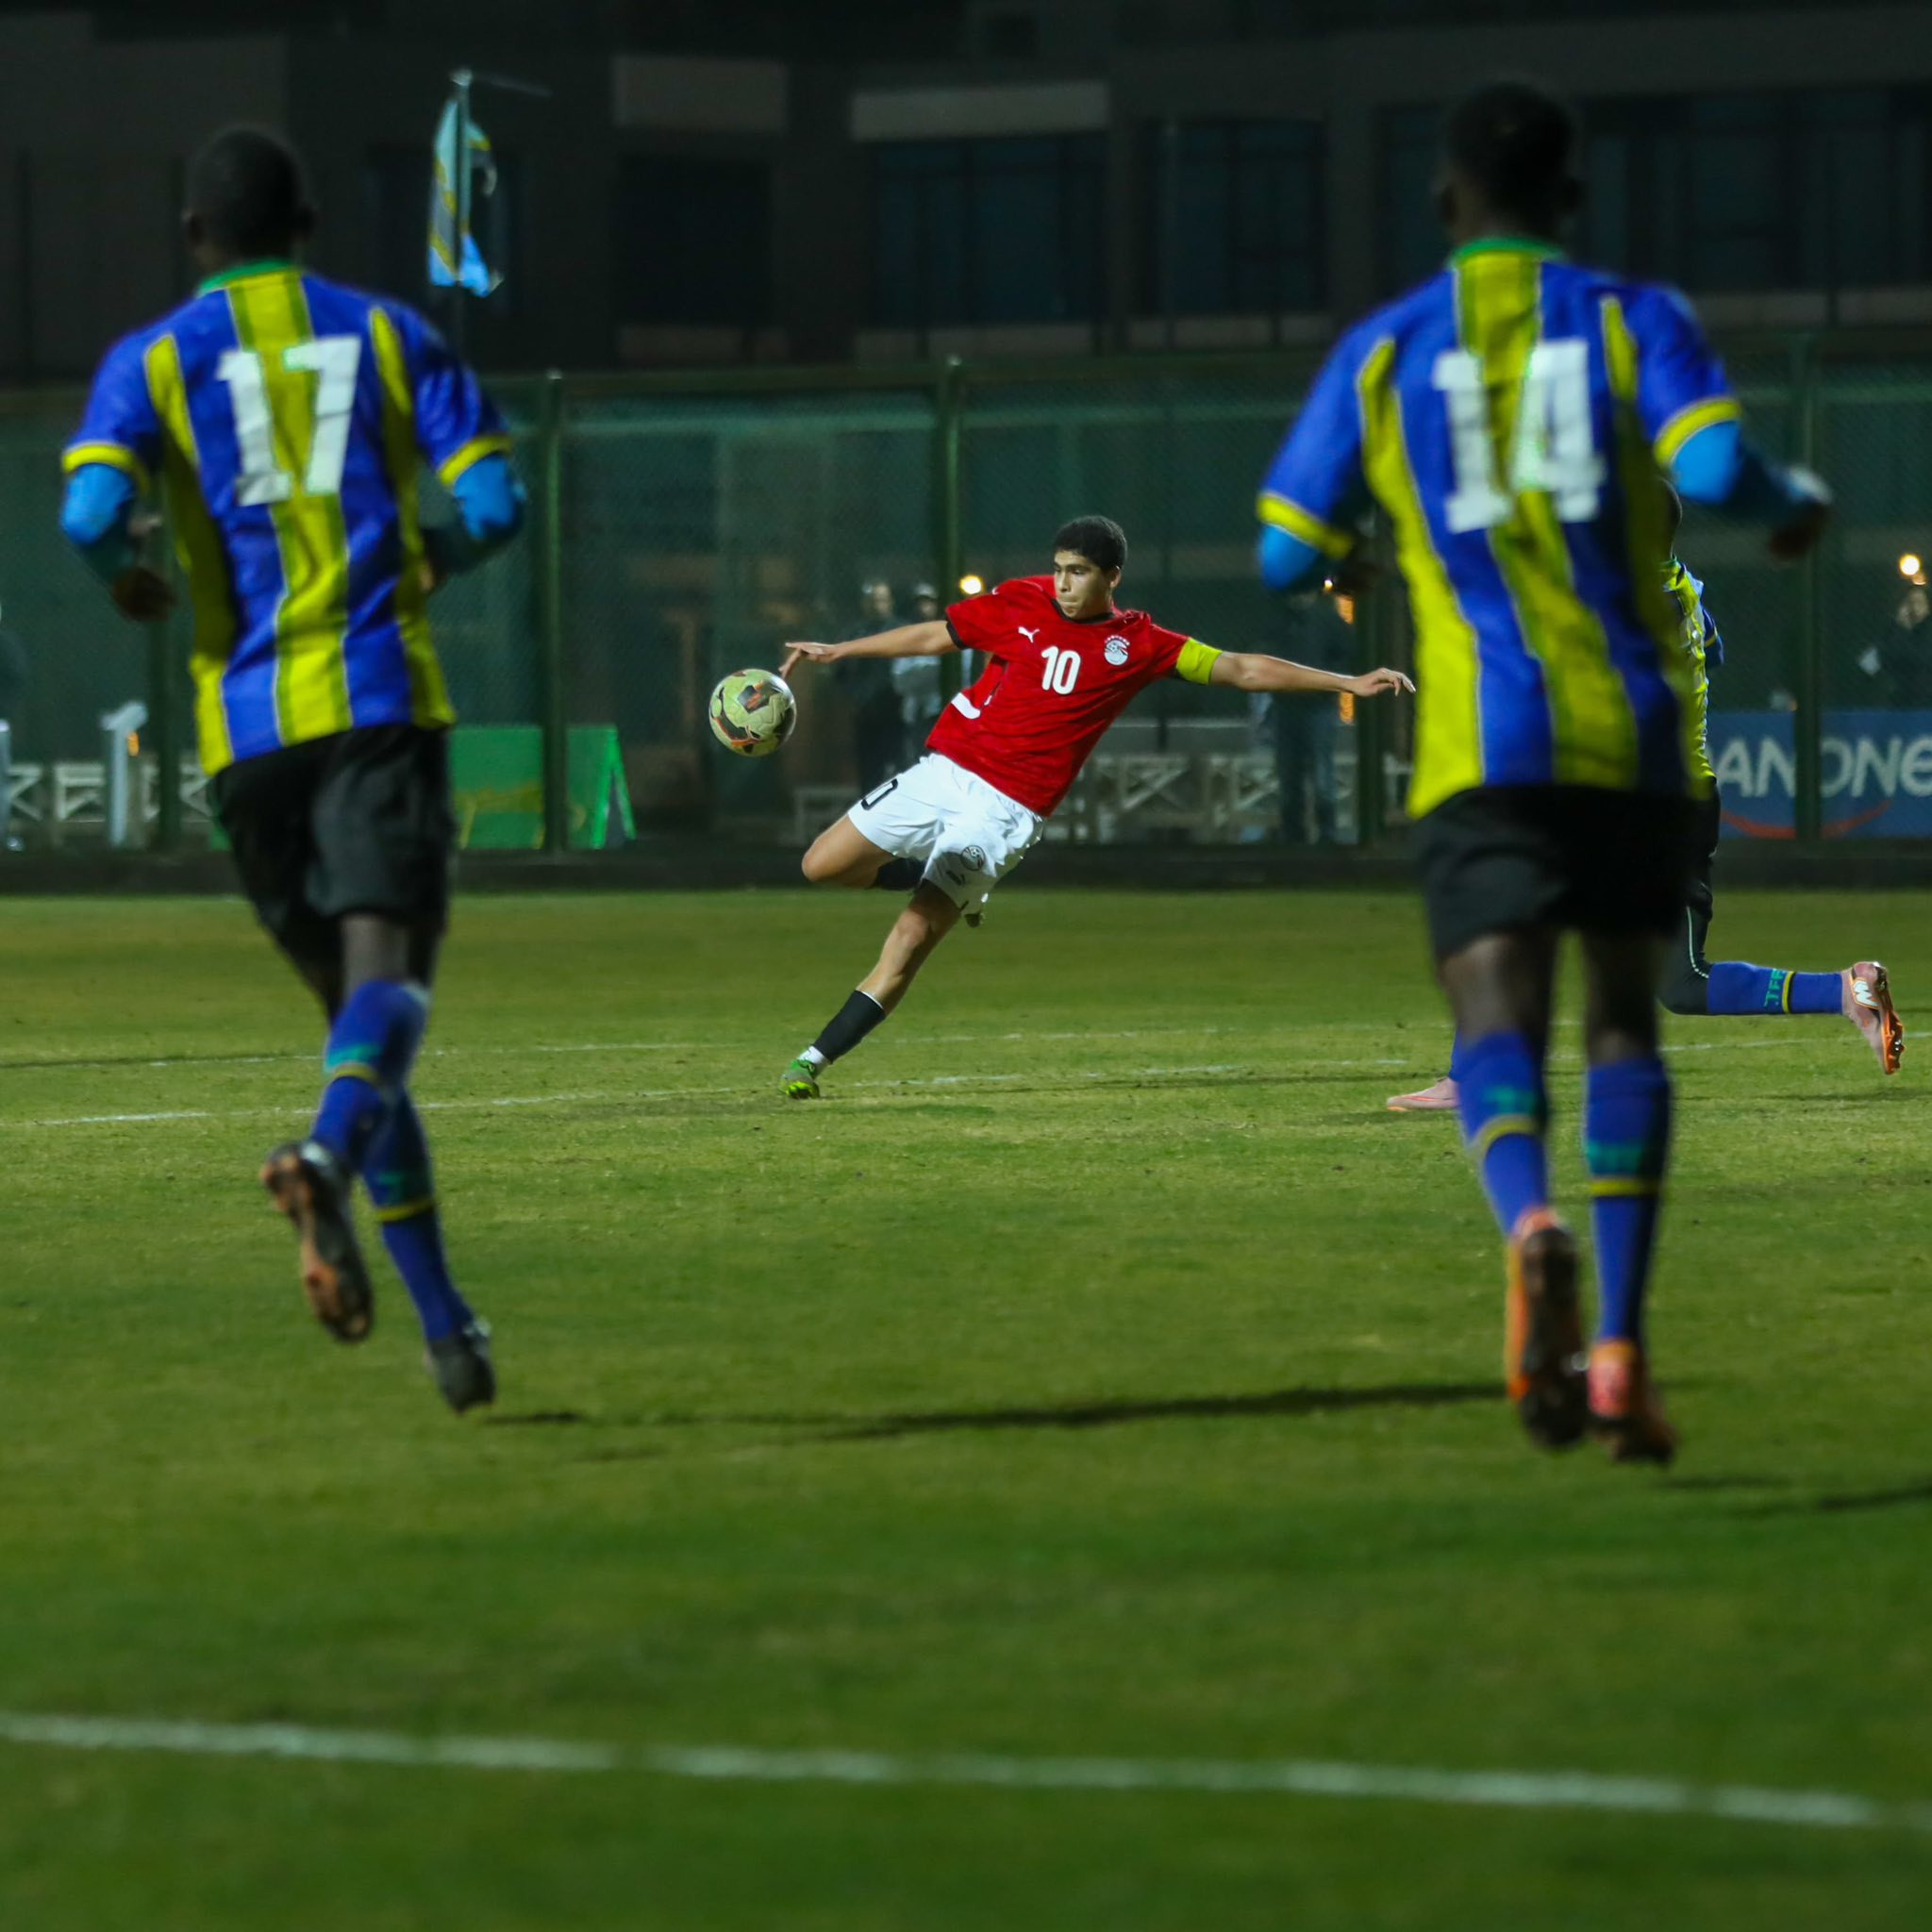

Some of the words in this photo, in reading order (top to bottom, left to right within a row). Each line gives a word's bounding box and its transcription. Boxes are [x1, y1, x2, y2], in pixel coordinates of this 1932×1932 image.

[216, 336, 361, 507] 17
[1432, 340, 1606, 534] 14
[1041, 645, 1081, 695] 10
